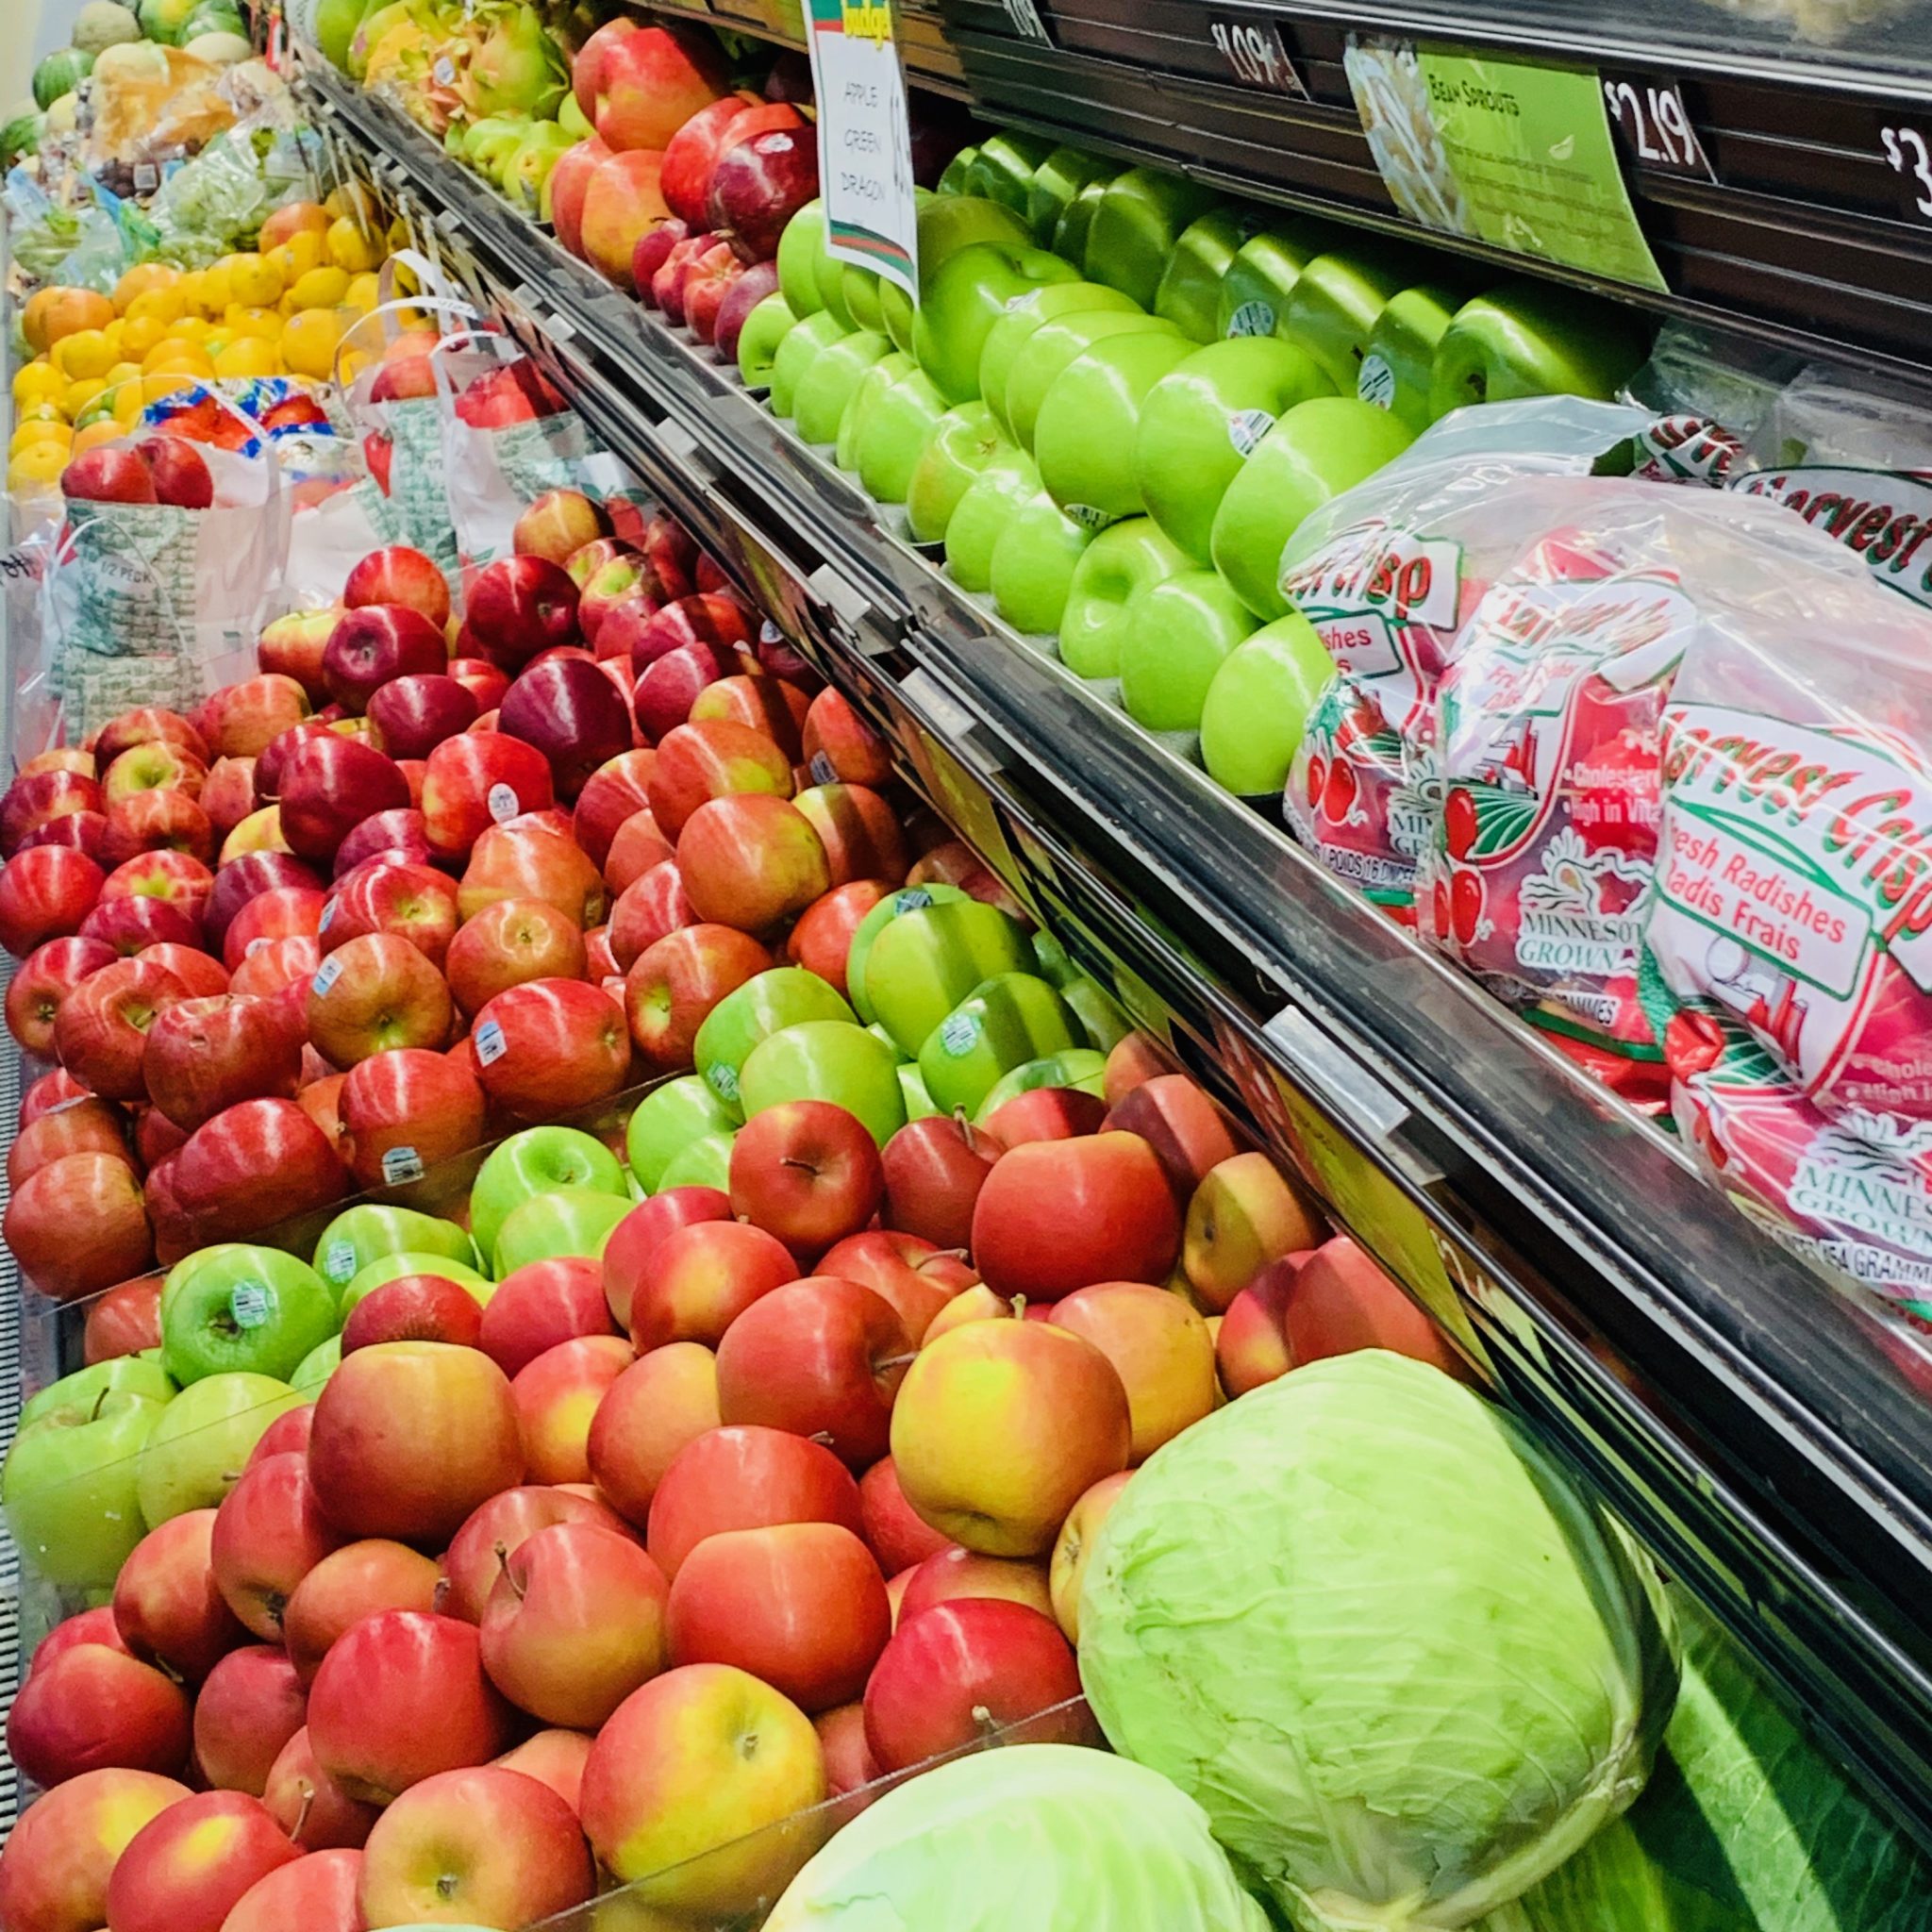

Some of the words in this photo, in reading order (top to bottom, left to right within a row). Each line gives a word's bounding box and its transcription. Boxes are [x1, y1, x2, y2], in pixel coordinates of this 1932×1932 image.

[844, 81, 877, 108] APPLE
[1605, 80, 1694, 165] $2.19
[844, 128, 881, 155] GREEN
[841, 171, 885, 203] DRAGON
[1723, 853, 1847, 944] Radishes
[1732, 898, 1802, 961] Frais
[1519, 939, 1620, 970] GROWN
